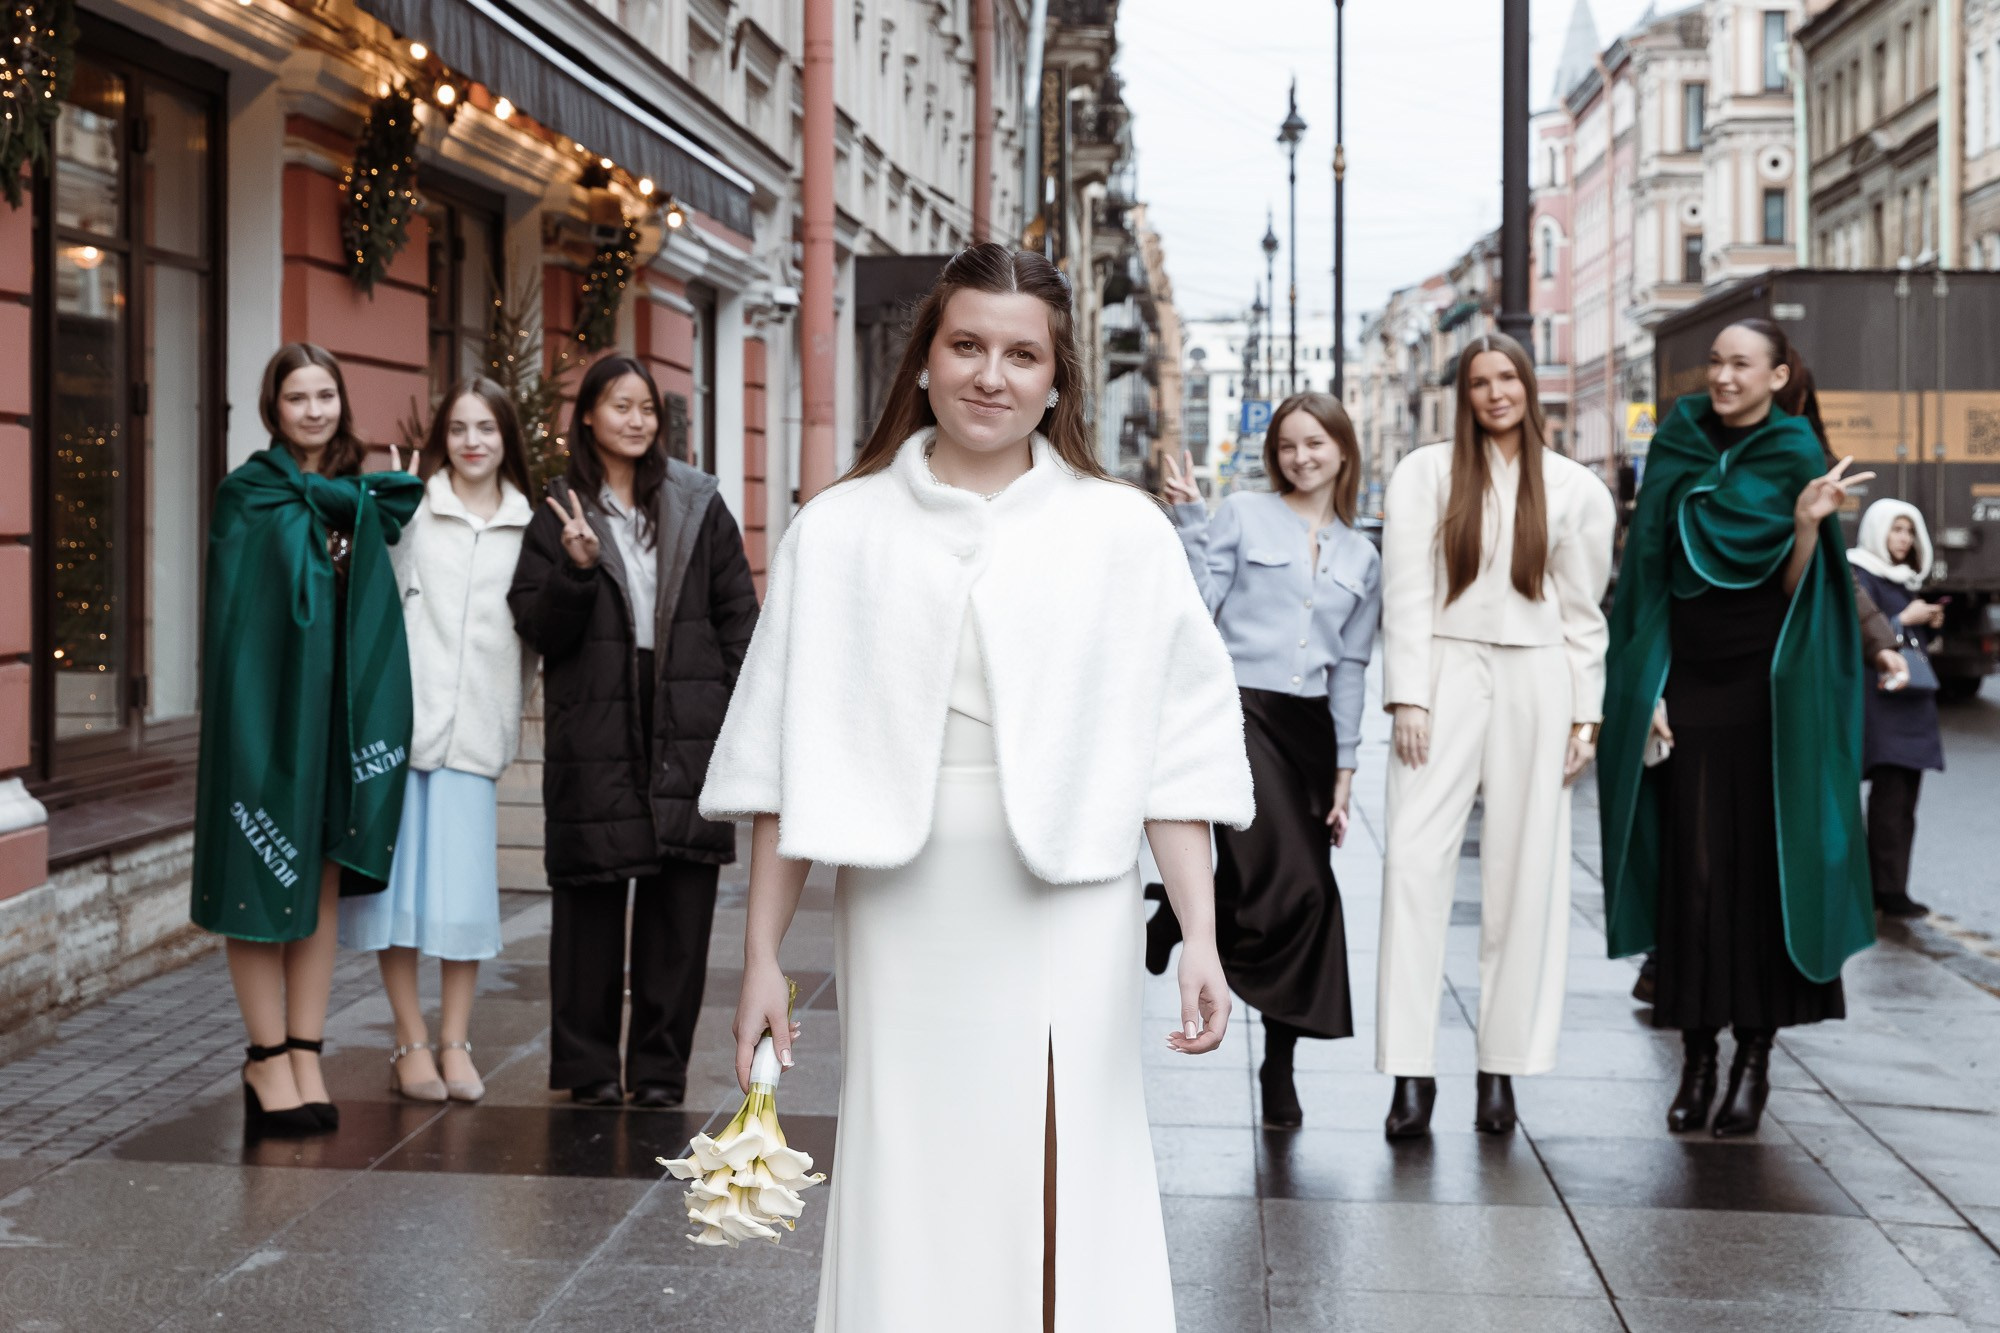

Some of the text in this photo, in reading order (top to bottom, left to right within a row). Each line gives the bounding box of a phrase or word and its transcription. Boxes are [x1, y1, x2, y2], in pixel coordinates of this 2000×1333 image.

[1248, 402, 1269, 429] P
[230, 801, 298, 888] HUNTING
[254, 807, 298, 860] BITTER
